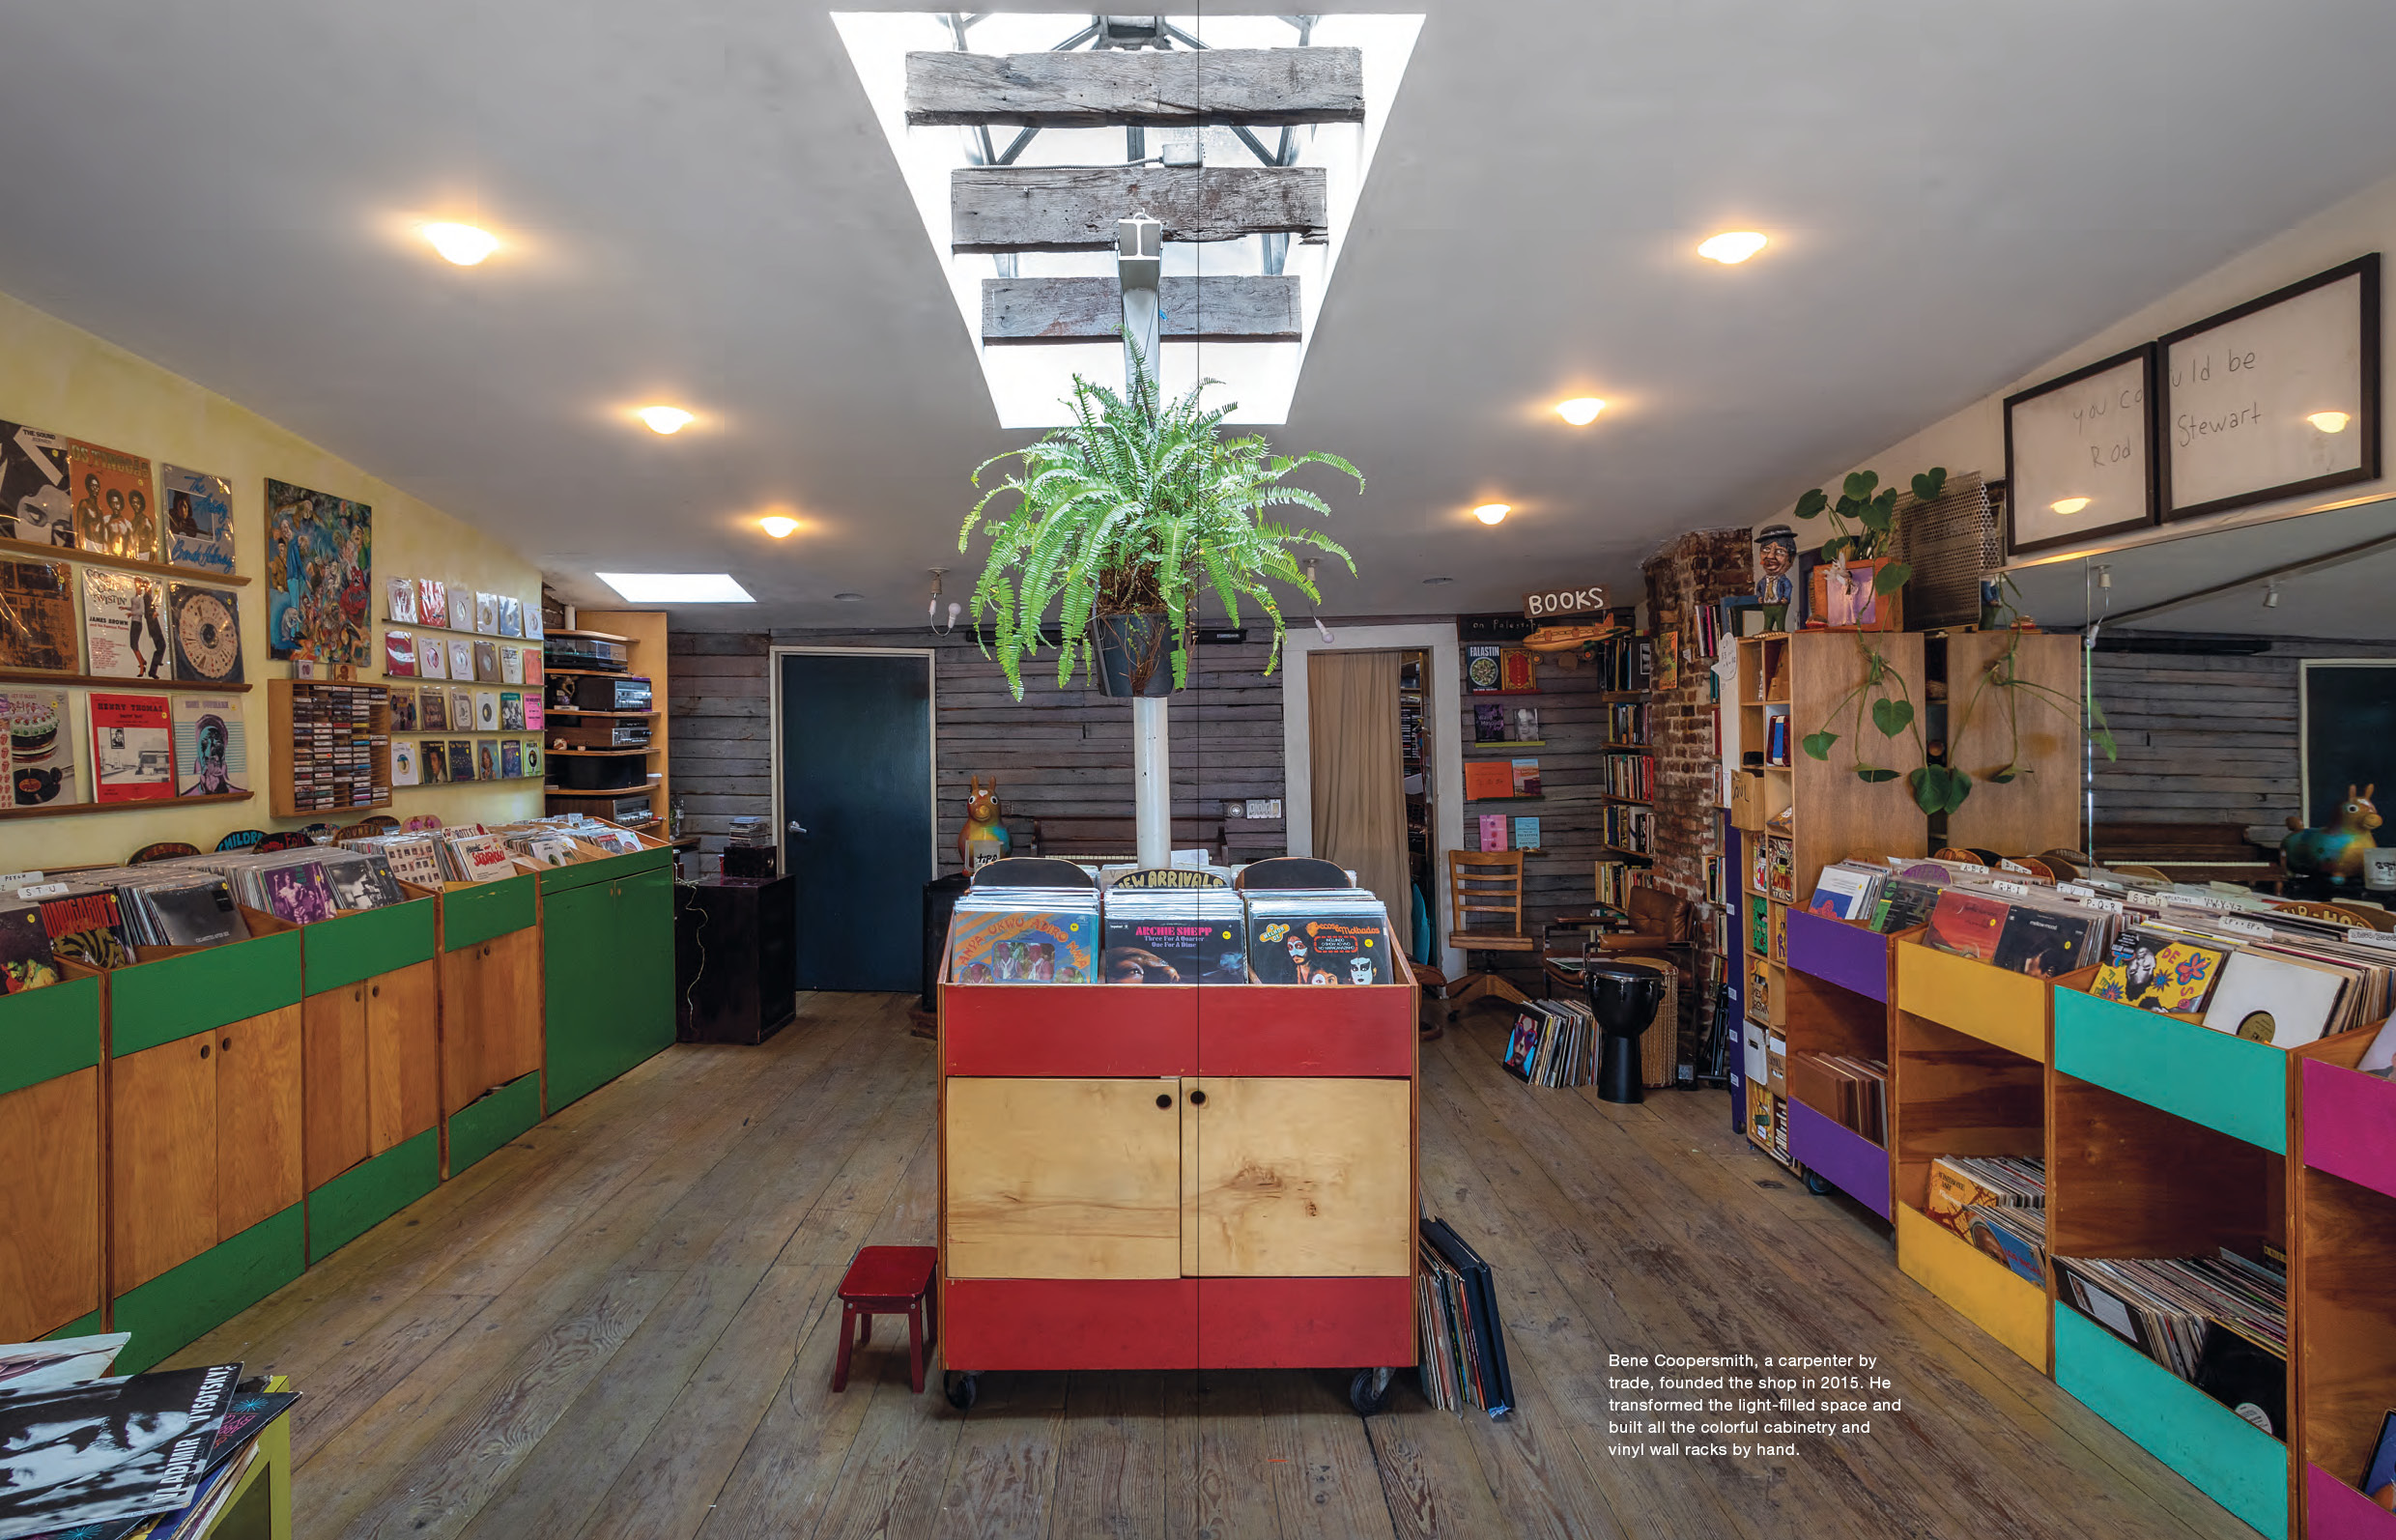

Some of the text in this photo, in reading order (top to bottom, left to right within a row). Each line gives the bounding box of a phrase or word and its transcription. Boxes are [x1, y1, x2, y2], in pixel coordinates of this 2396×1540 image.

[2229, 349, 2255, 372] be
[2073, 398, 2106, 435] you
[2178, 402, 2261, 446] Stewart
[2091, 438, 2130, 468] Rod
[1528, 587, 1604, 615] BOOKS
[1469, 645, 1499, 657] FALASTIN
[218, 832, 263, 852] CHILDR
[40, 893, 121, 938] UNDGARDEN
[987, 917, 1025, 935] UKWU
[1030, 918, 1070, 943] ADIRO
[1135, 927, 1212, 936] ARCHIE SHEPP
[1939, 1171, 1965, 1191] WISHBONE
[185, 1365, 230, 1425] VYSOTSKY
[152, 1437, 201, 1504] VLADIMIR
